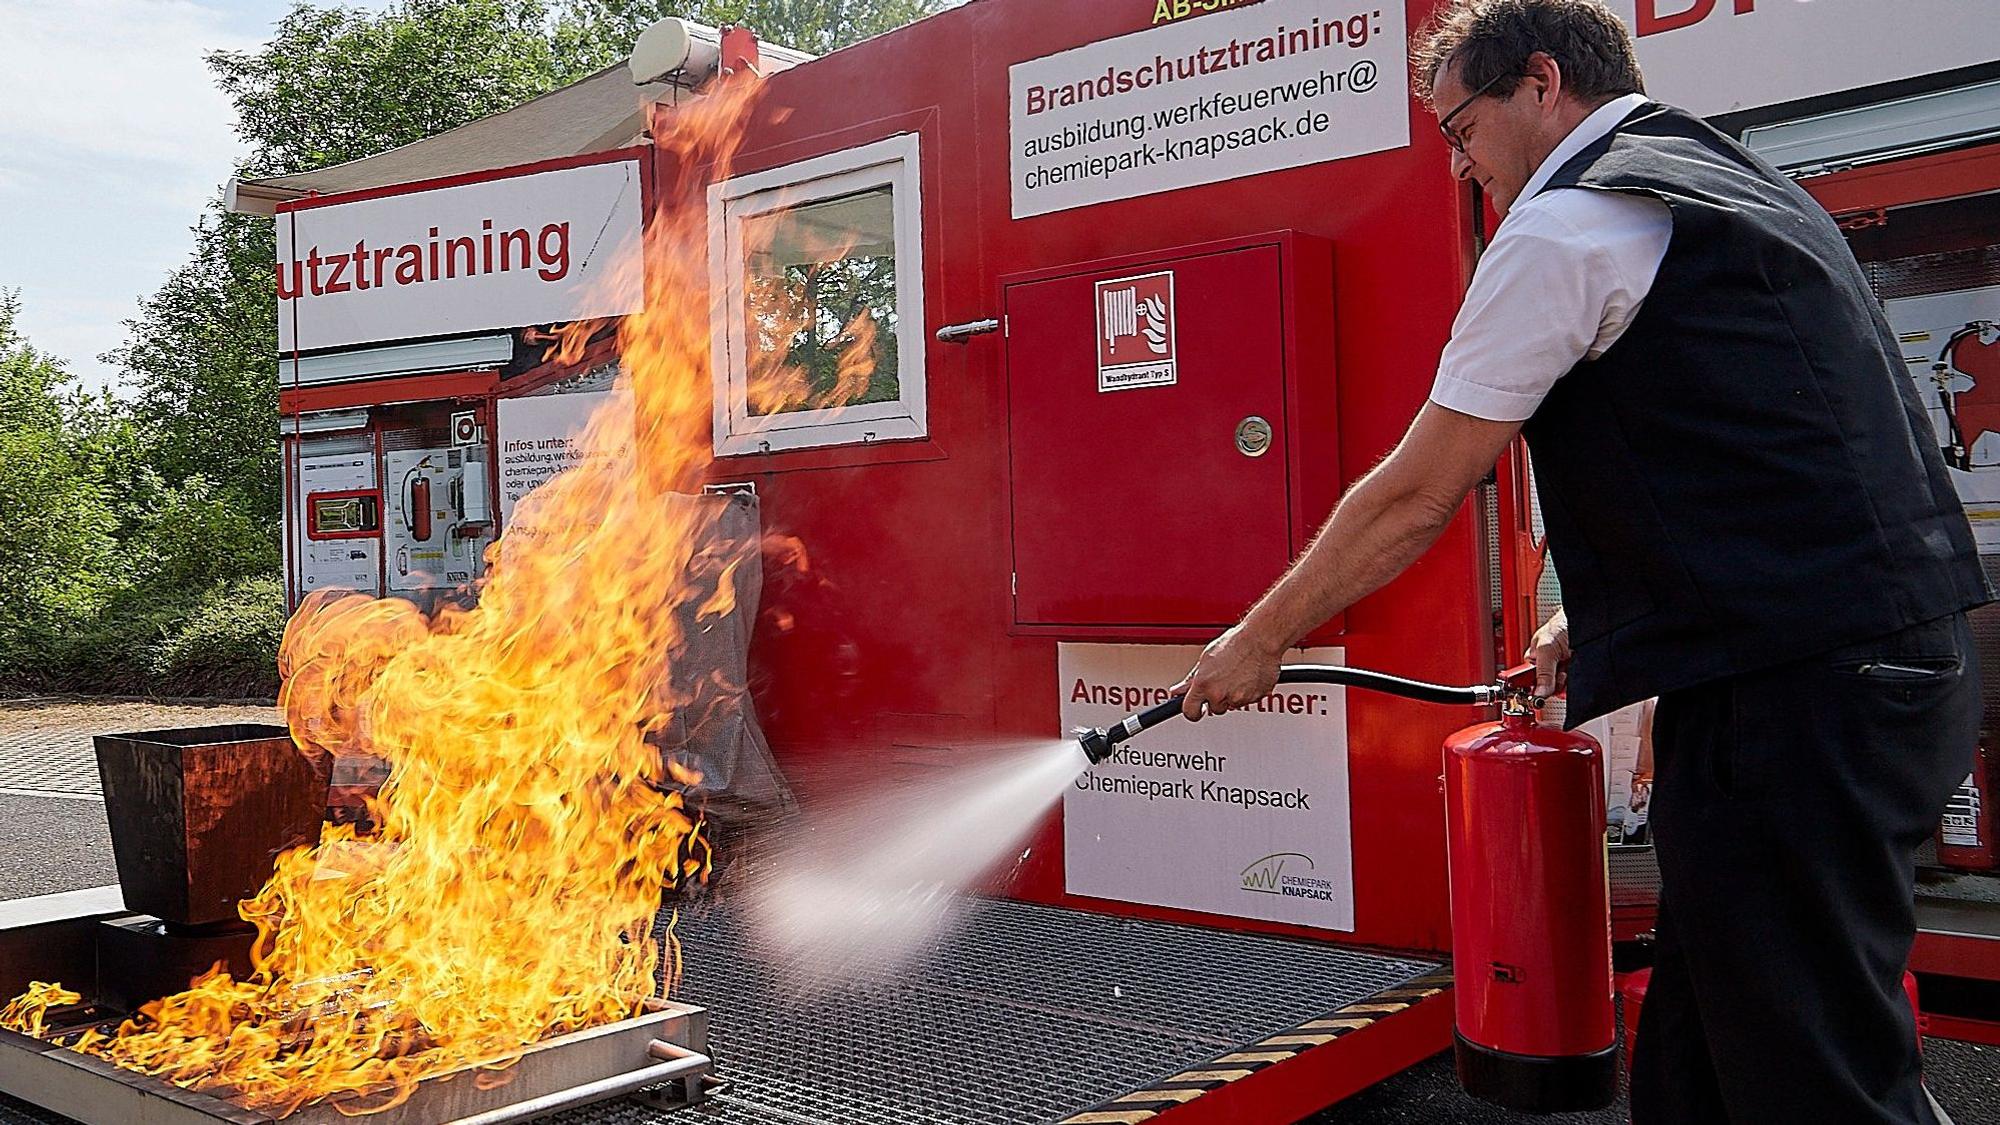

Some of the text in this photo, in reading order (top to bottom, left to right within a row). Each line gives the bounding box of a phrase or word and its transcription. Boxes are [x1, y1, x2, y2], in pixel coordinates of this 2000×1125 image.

[1026, 10, 1382, 116] Brandschutztraining:
[1024, 60, 1378, 158] ausbildung.werkfeuerwehr@
[1024, 109, 1330, 190] chemiepark-knapsack.de
[1150, 370, 1163, 379] Typ
[1164, 369, 1170, 377] S
[504, 438, 573, 453] Infos unter:
[1075, 771, 1311, 810] Chemiepark Knapsack
[1281, 875, 1332, 889] CHEMIEPARK
[1282, 886, 1333, 901] KNAPSACK
